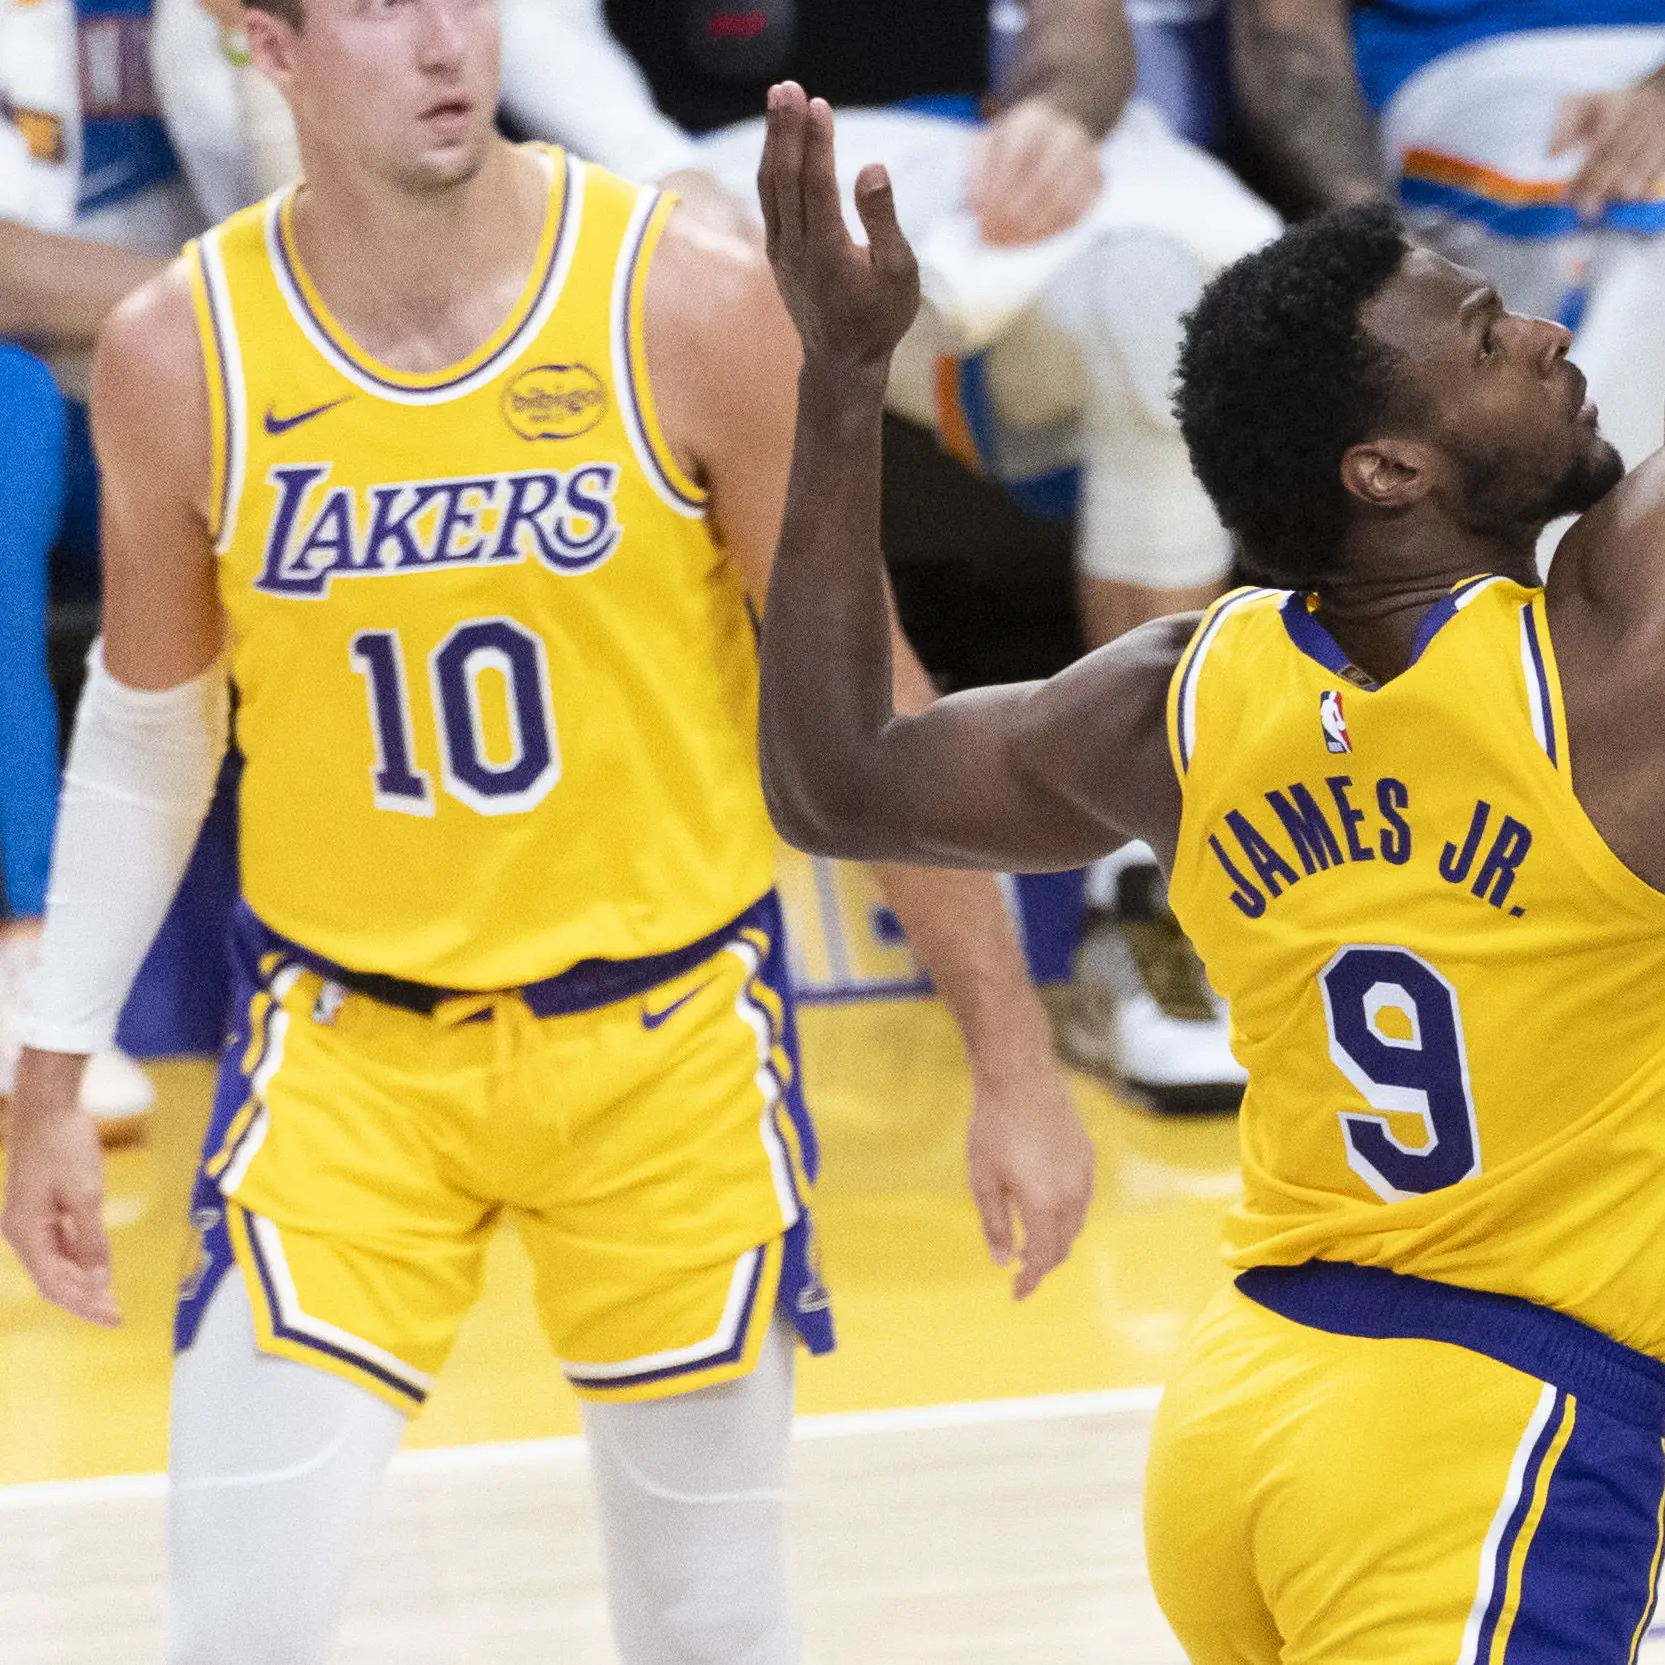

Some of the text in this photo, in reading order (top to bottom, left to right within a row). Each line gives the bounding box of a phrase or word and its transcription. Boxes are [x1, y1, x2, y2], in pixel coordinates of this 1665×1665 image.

[253, 460, 623, 601] LAKERS
[349, 614, 562, 818] 10
[1207, 774, 1533, 920] JAMES JR.
[1316, 942, 1484, 1205] 9
